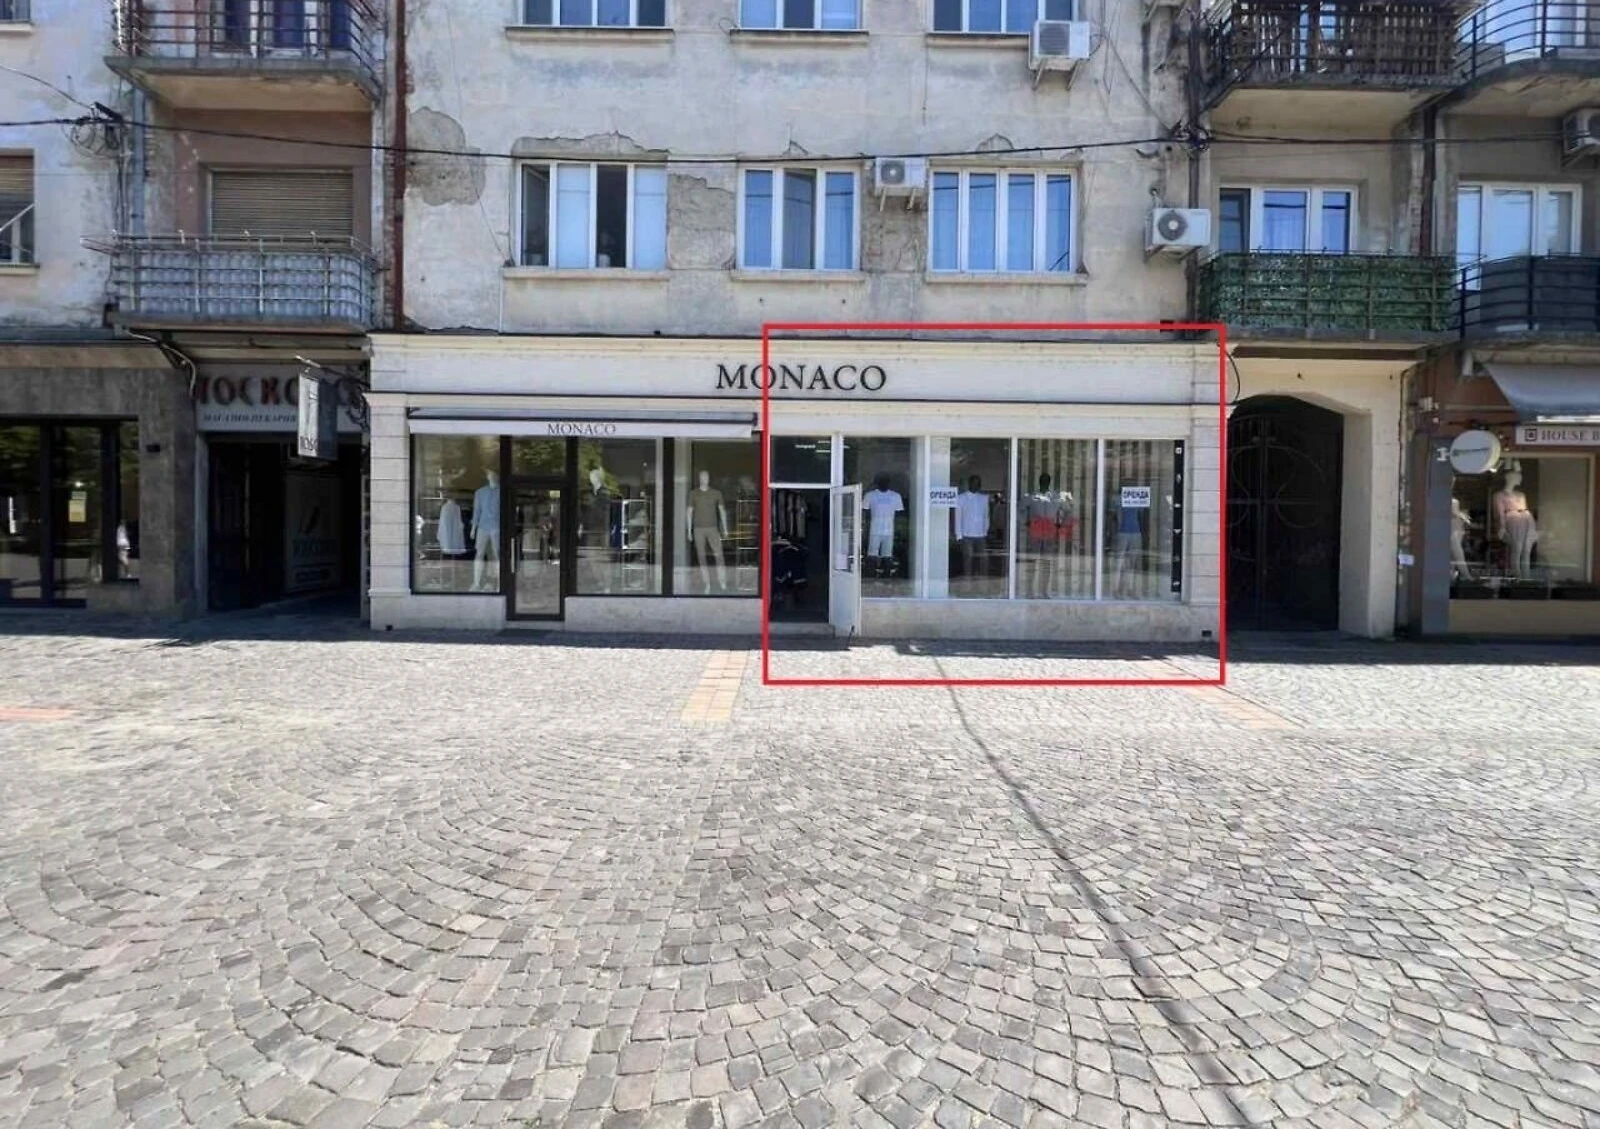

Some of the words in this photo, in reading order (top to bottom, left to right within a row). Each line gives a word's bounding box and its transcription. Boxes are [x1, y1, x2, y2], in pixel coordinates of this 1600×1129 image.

[715, 364, 887, 391] MONACO
[548, 423, 616, 435] MONACO
[1541, 430, 1585, 440] HOUSE
[930, 490, 956, 499] ОРЕНДА
[1123, 490, 1149, 499] ОРЕНДА
